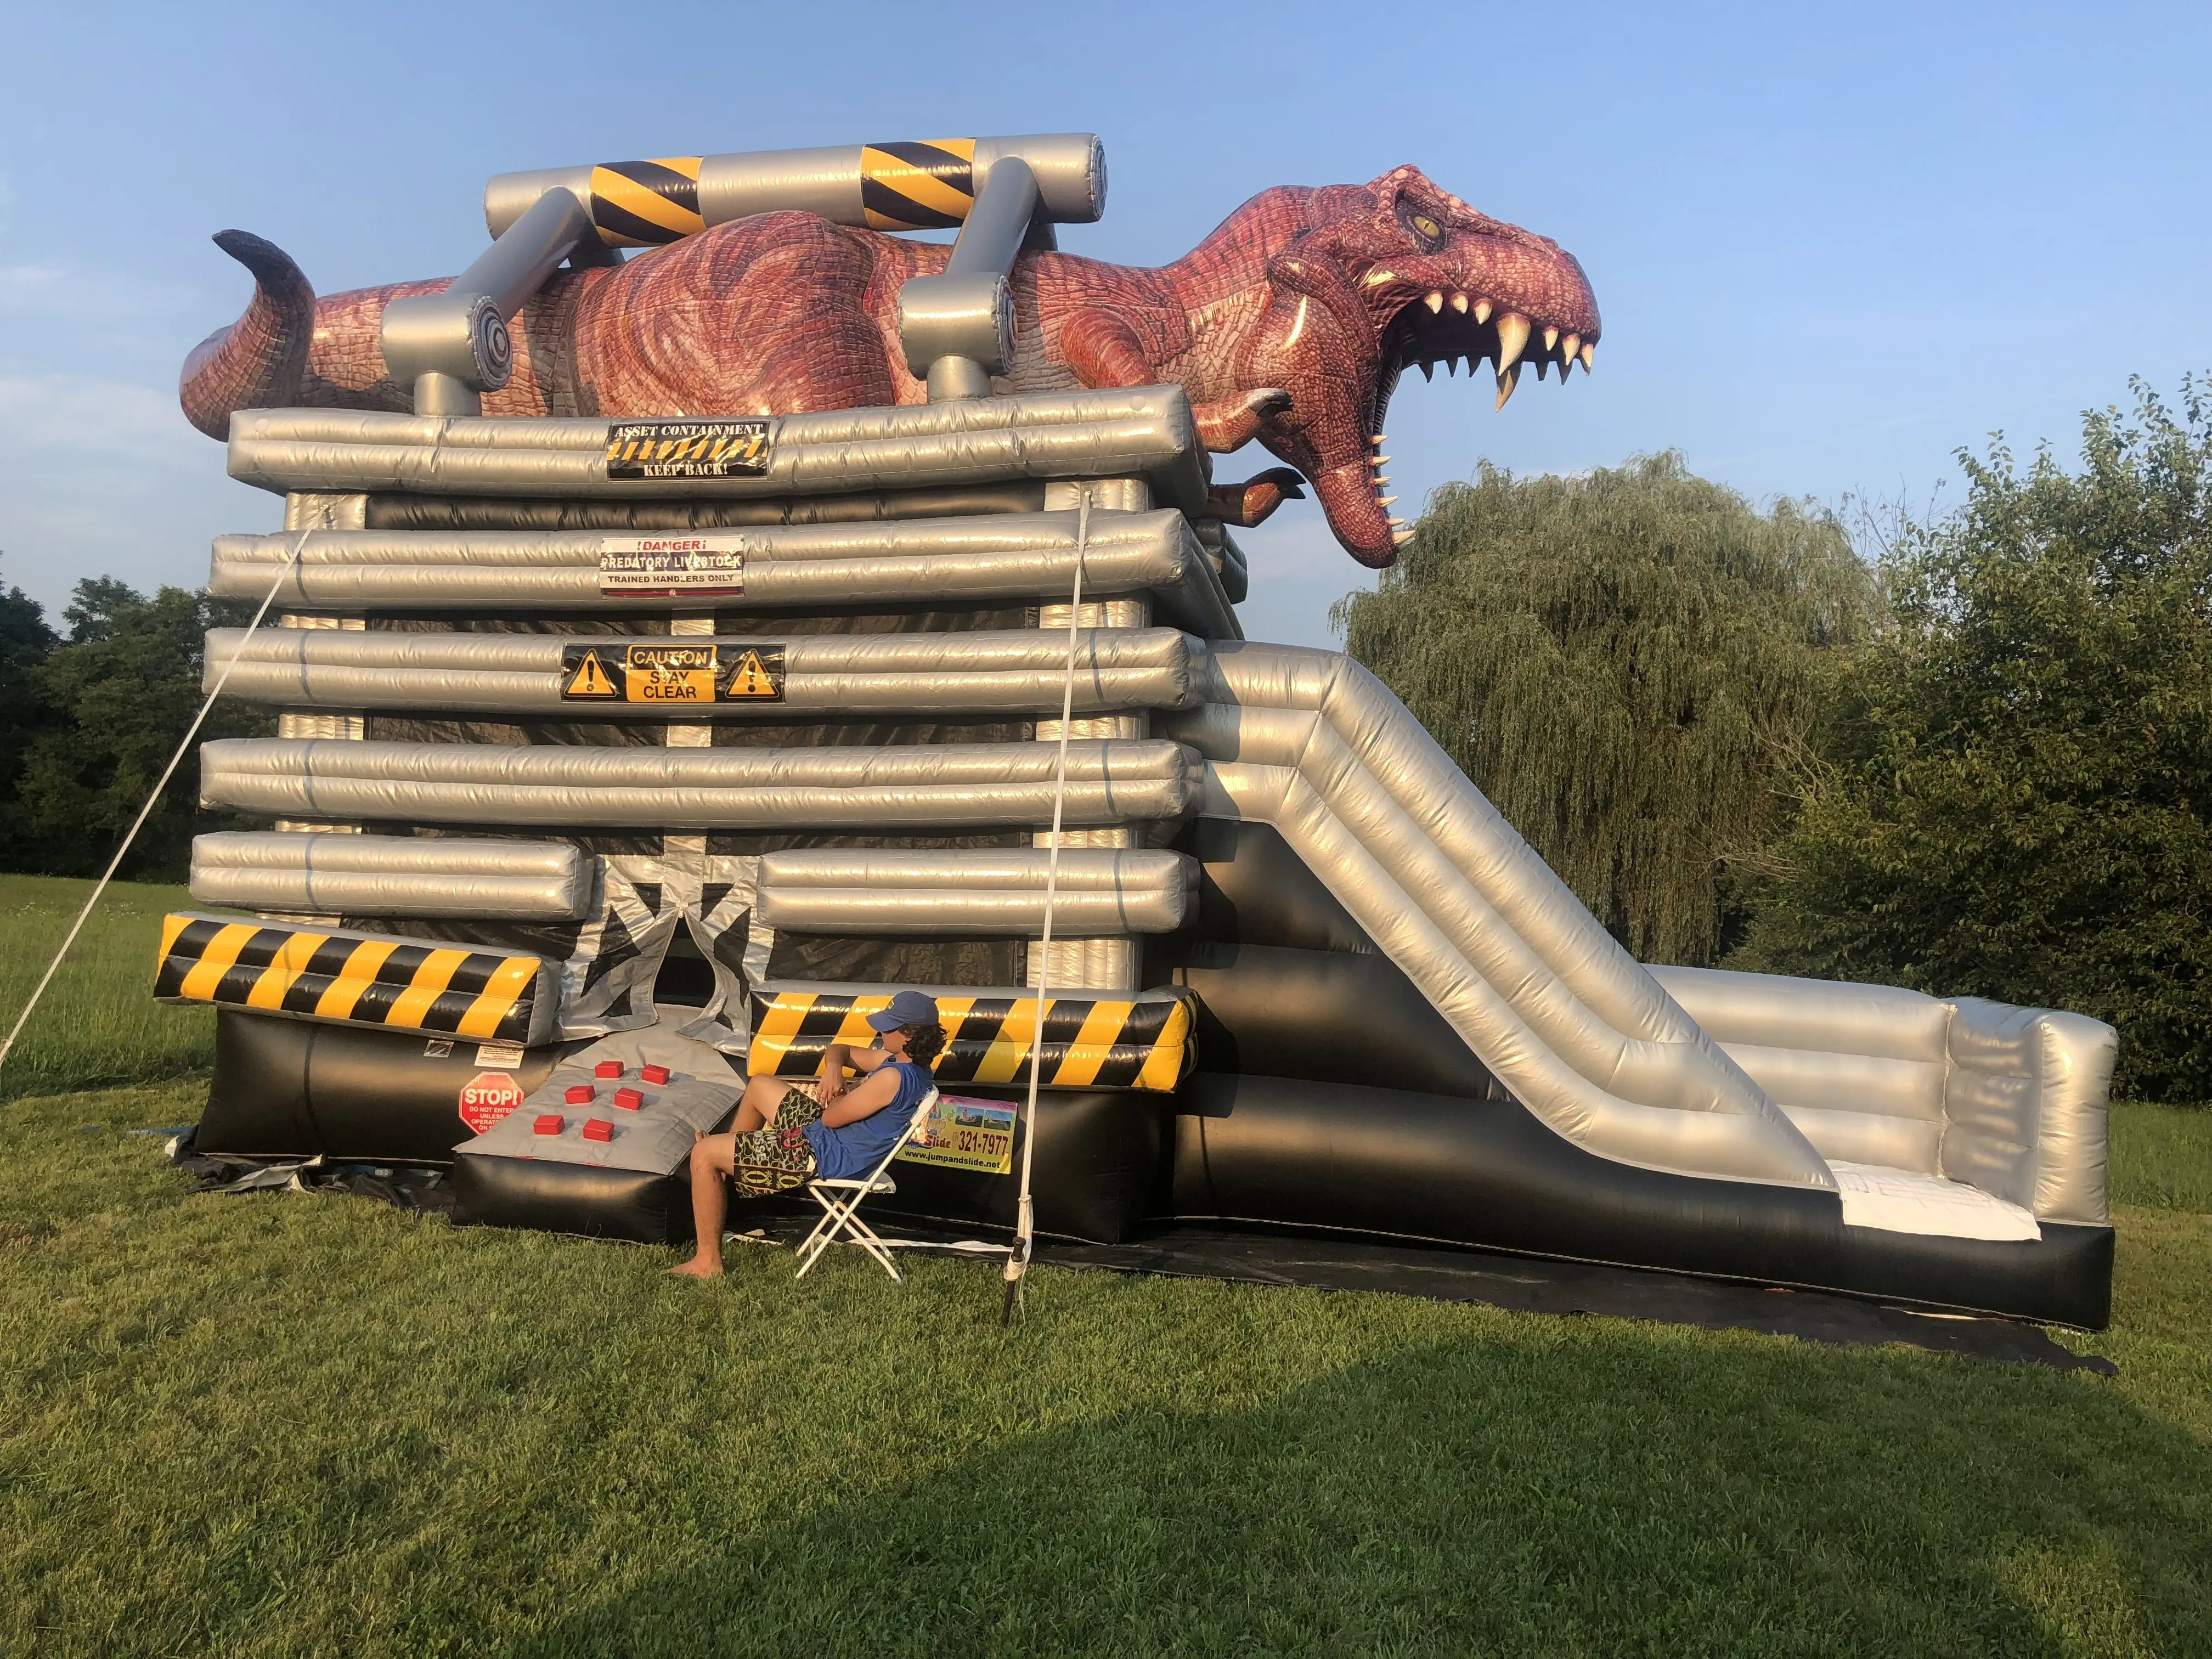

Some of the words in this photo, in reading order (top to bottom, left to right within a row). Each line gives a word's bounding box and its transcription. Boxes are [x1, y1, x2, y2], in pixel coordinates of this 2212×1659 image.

[614, 426, 658, 437] ASSET
[661, 424, 763, 436] CONTAINMENT
[644, 464, 680, 476] KEEP
[685, 462, 729, 476] BACK!
[600, 556, 670, 569] PREDATORY
[634, 651, 708, 664] CAUTION
[644, 685, 697, 698] CLEAR
[465, 1088, 518, 1105] STOP!
[923, 1135, 951, 1149] Slide
[958, 1130, 1009, 1156] 321-7977
[905, 1150, 1000, 1169] www.jumpandslide.net
